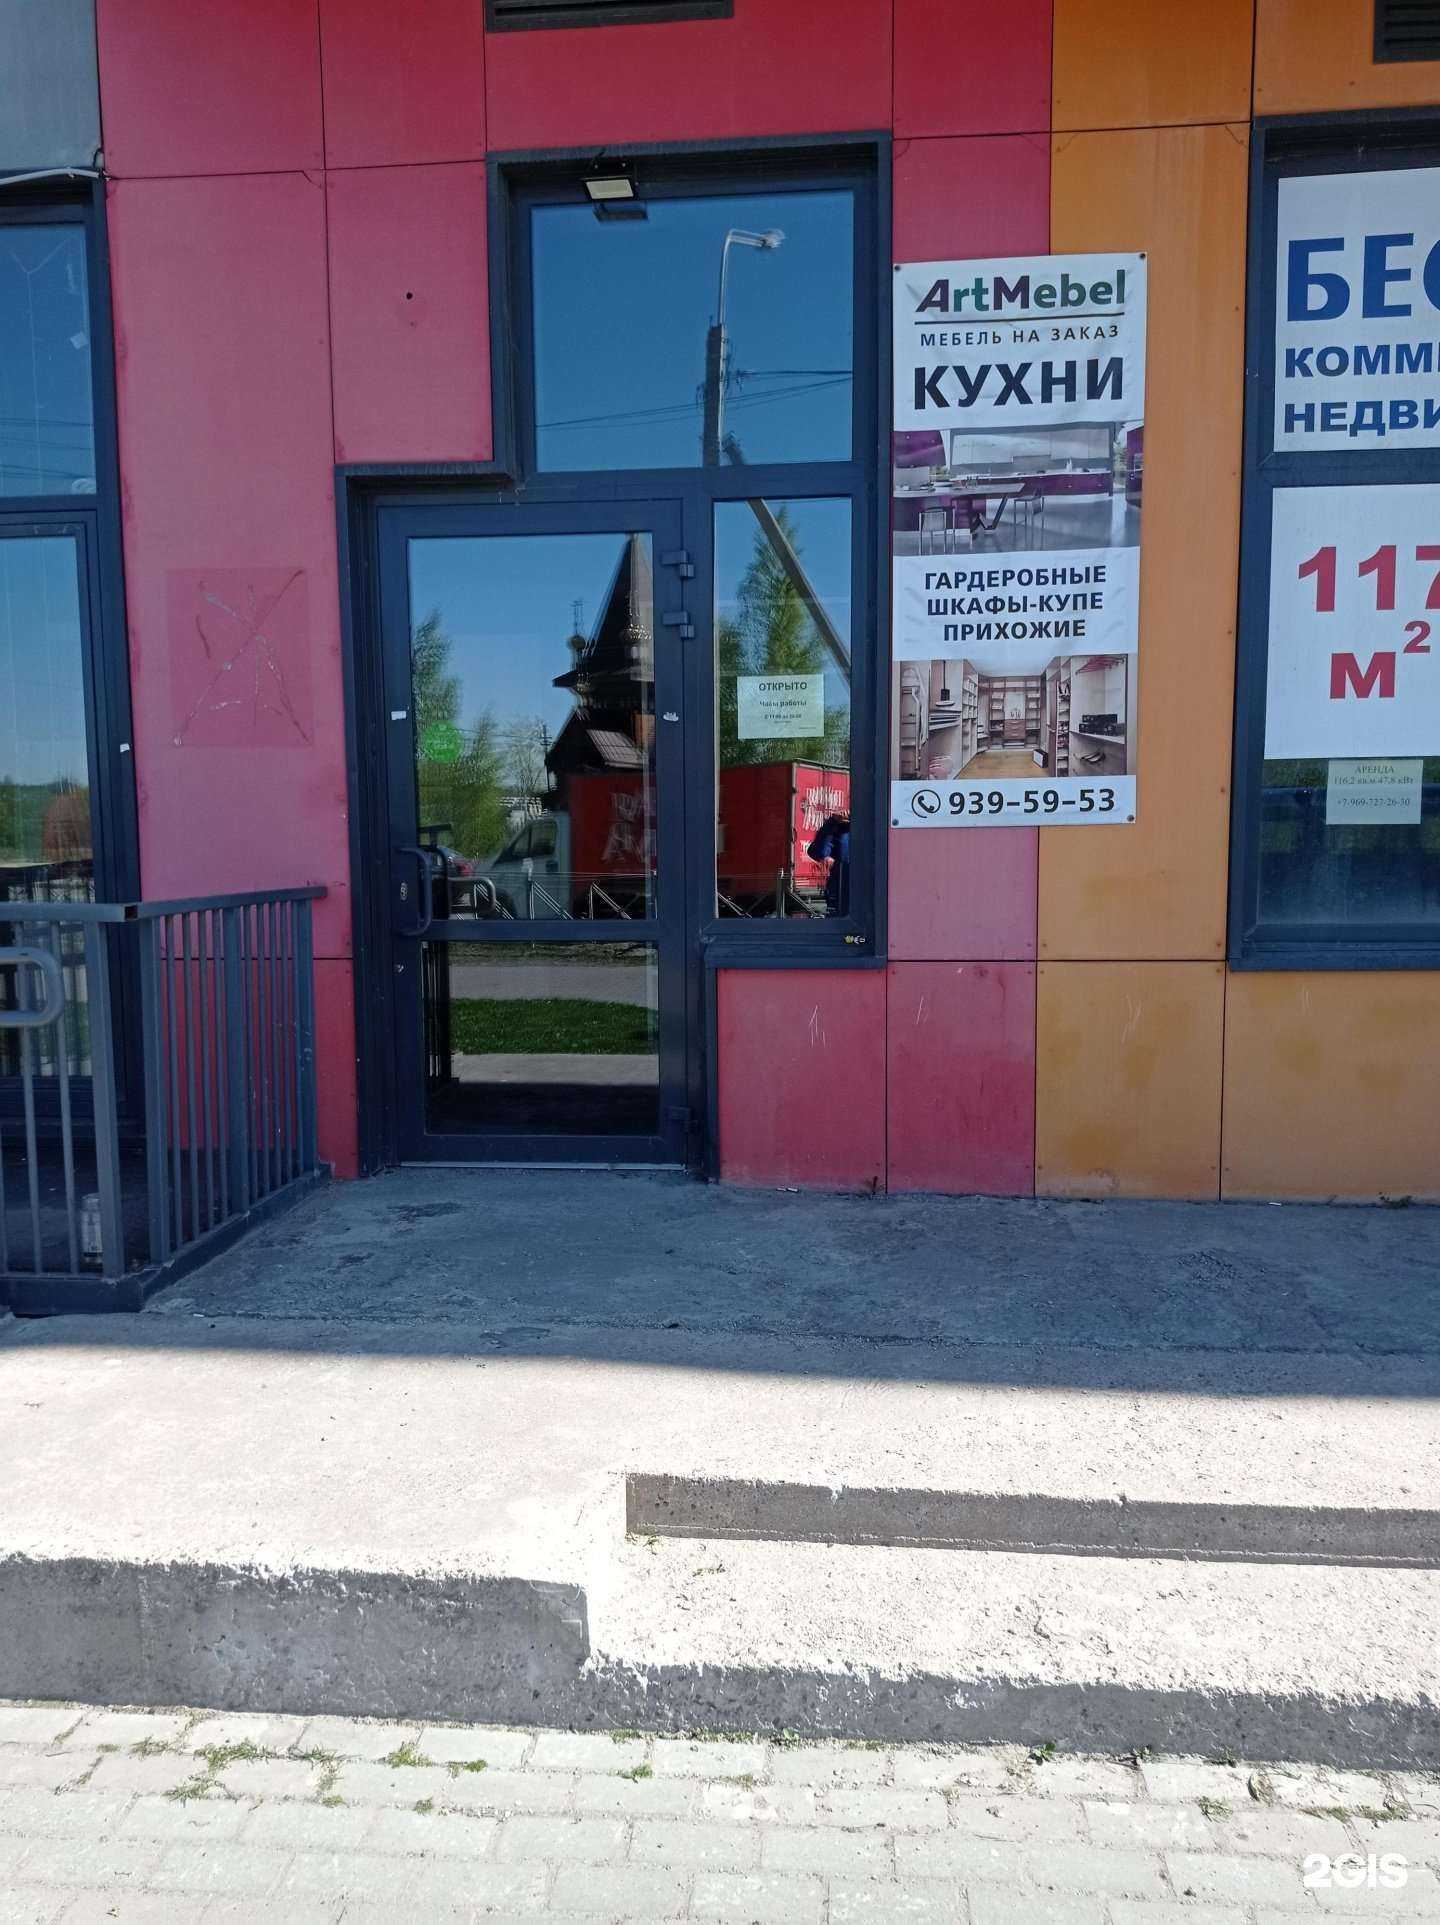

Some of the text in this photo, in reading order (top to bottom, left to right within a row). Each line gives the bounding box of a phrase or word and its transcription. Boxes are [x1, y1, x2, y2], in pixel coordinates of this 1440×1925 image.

[915, 269, 1125, 313] ArtMebel
[920, 325, 1119, 347] МЕБЕЛЬ НА ЗАКАЗ
[1285, 342, 1440, 379] КОММ
[914, 357, 1124, 410] КУХНИ
[924, 565, 1107, 592] ГАРДЕРОБНЫЕ
[1298, 545, 1440, 612] 117
[927, 592, 1103, 616] ШКАФЫ-КУПЕ
[943, 619, 1086, 642] ПРИХОЖИЕ
[758, 681, 808, 691] ОТКРЫТО
[779, 699, 807, 708] работы
[1354, 765, 1395, 774] АРЕНДА
[949, 788, 1116, 815] 939-59-53
